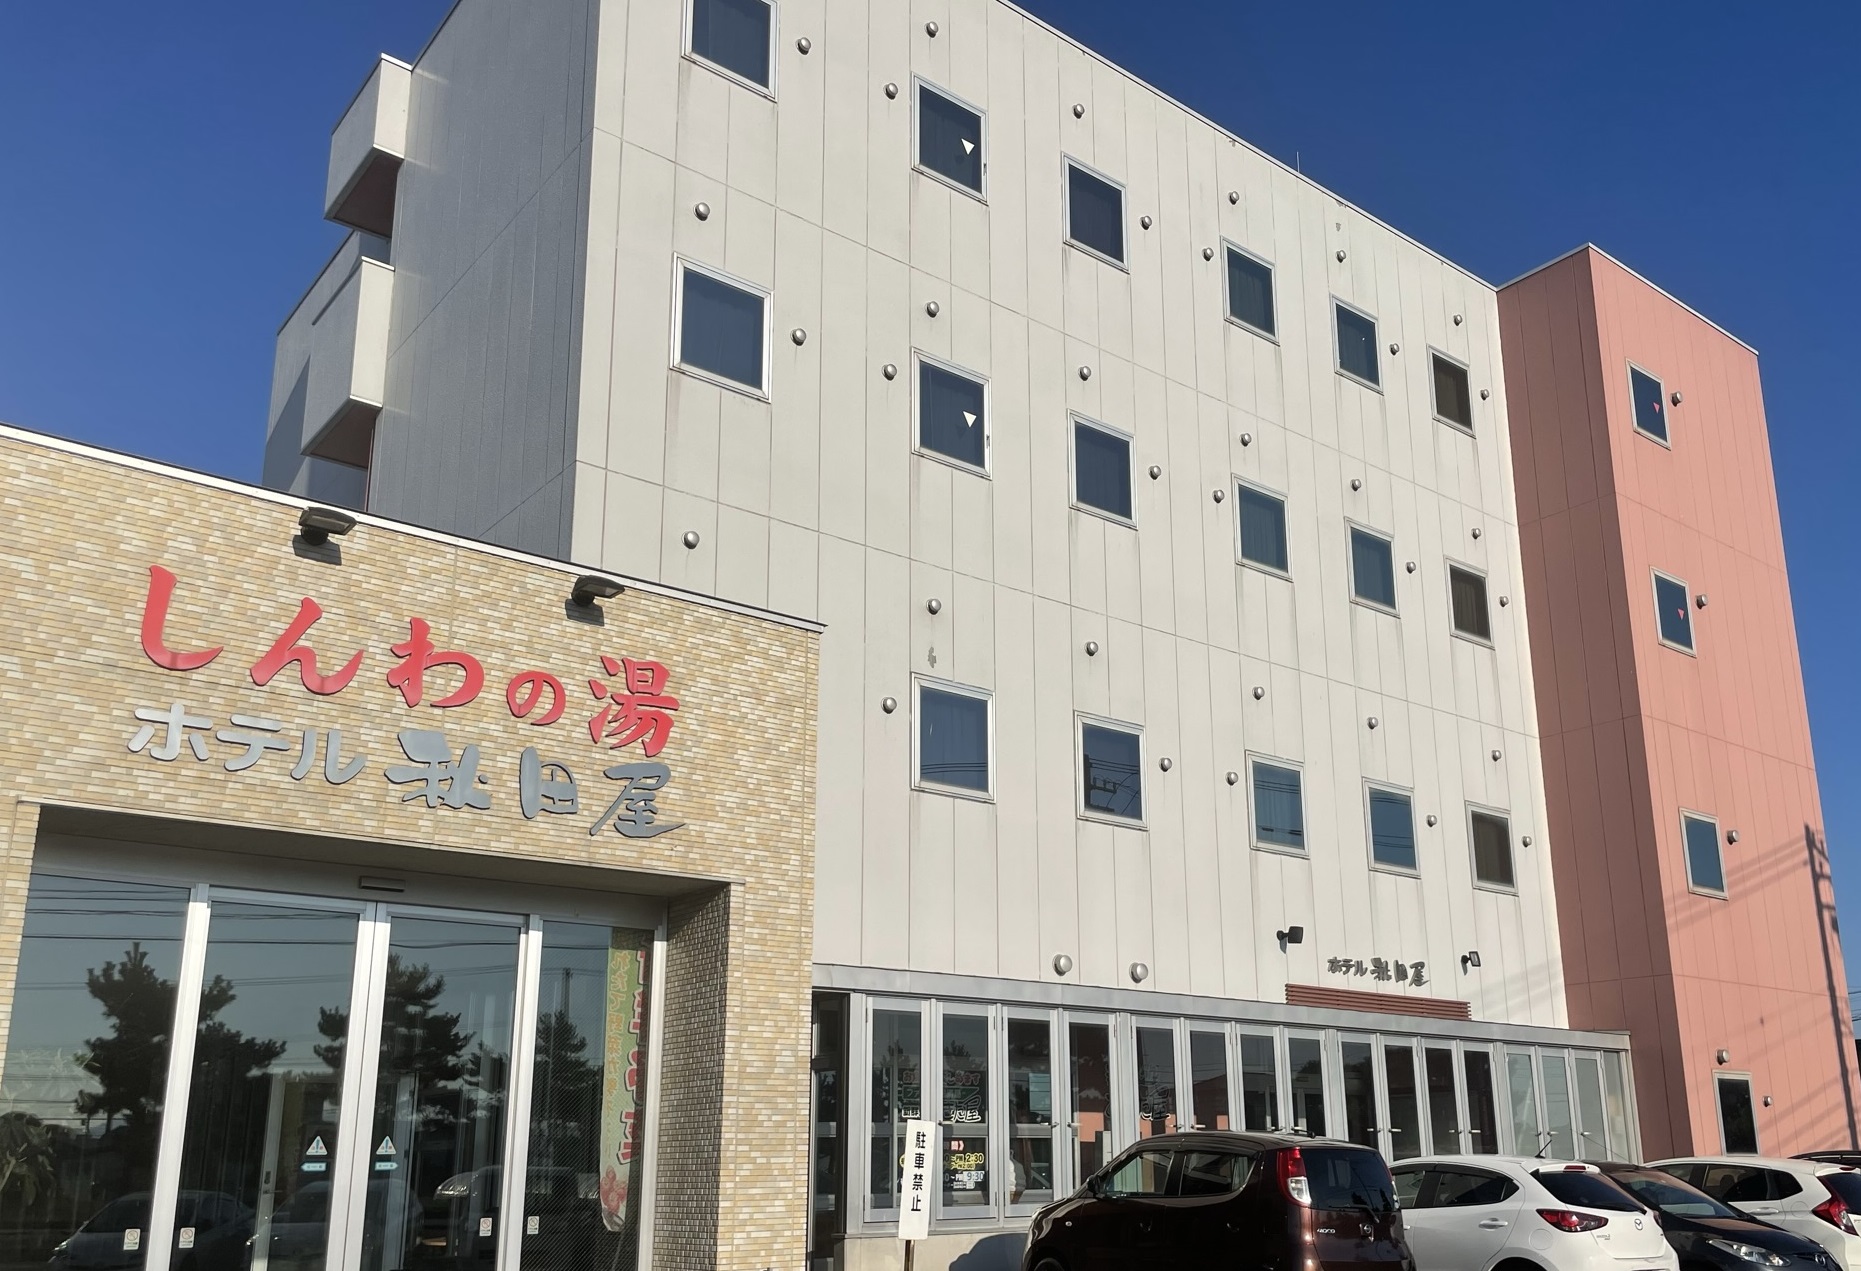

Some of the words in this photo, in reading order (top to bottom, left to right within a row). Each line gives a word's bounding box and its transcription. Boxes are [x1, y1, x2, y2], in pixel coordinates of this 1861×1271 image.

[141, 565, 680, 757] しんわの湯
[911, 1131, 926, 1212] 駐車禁止
